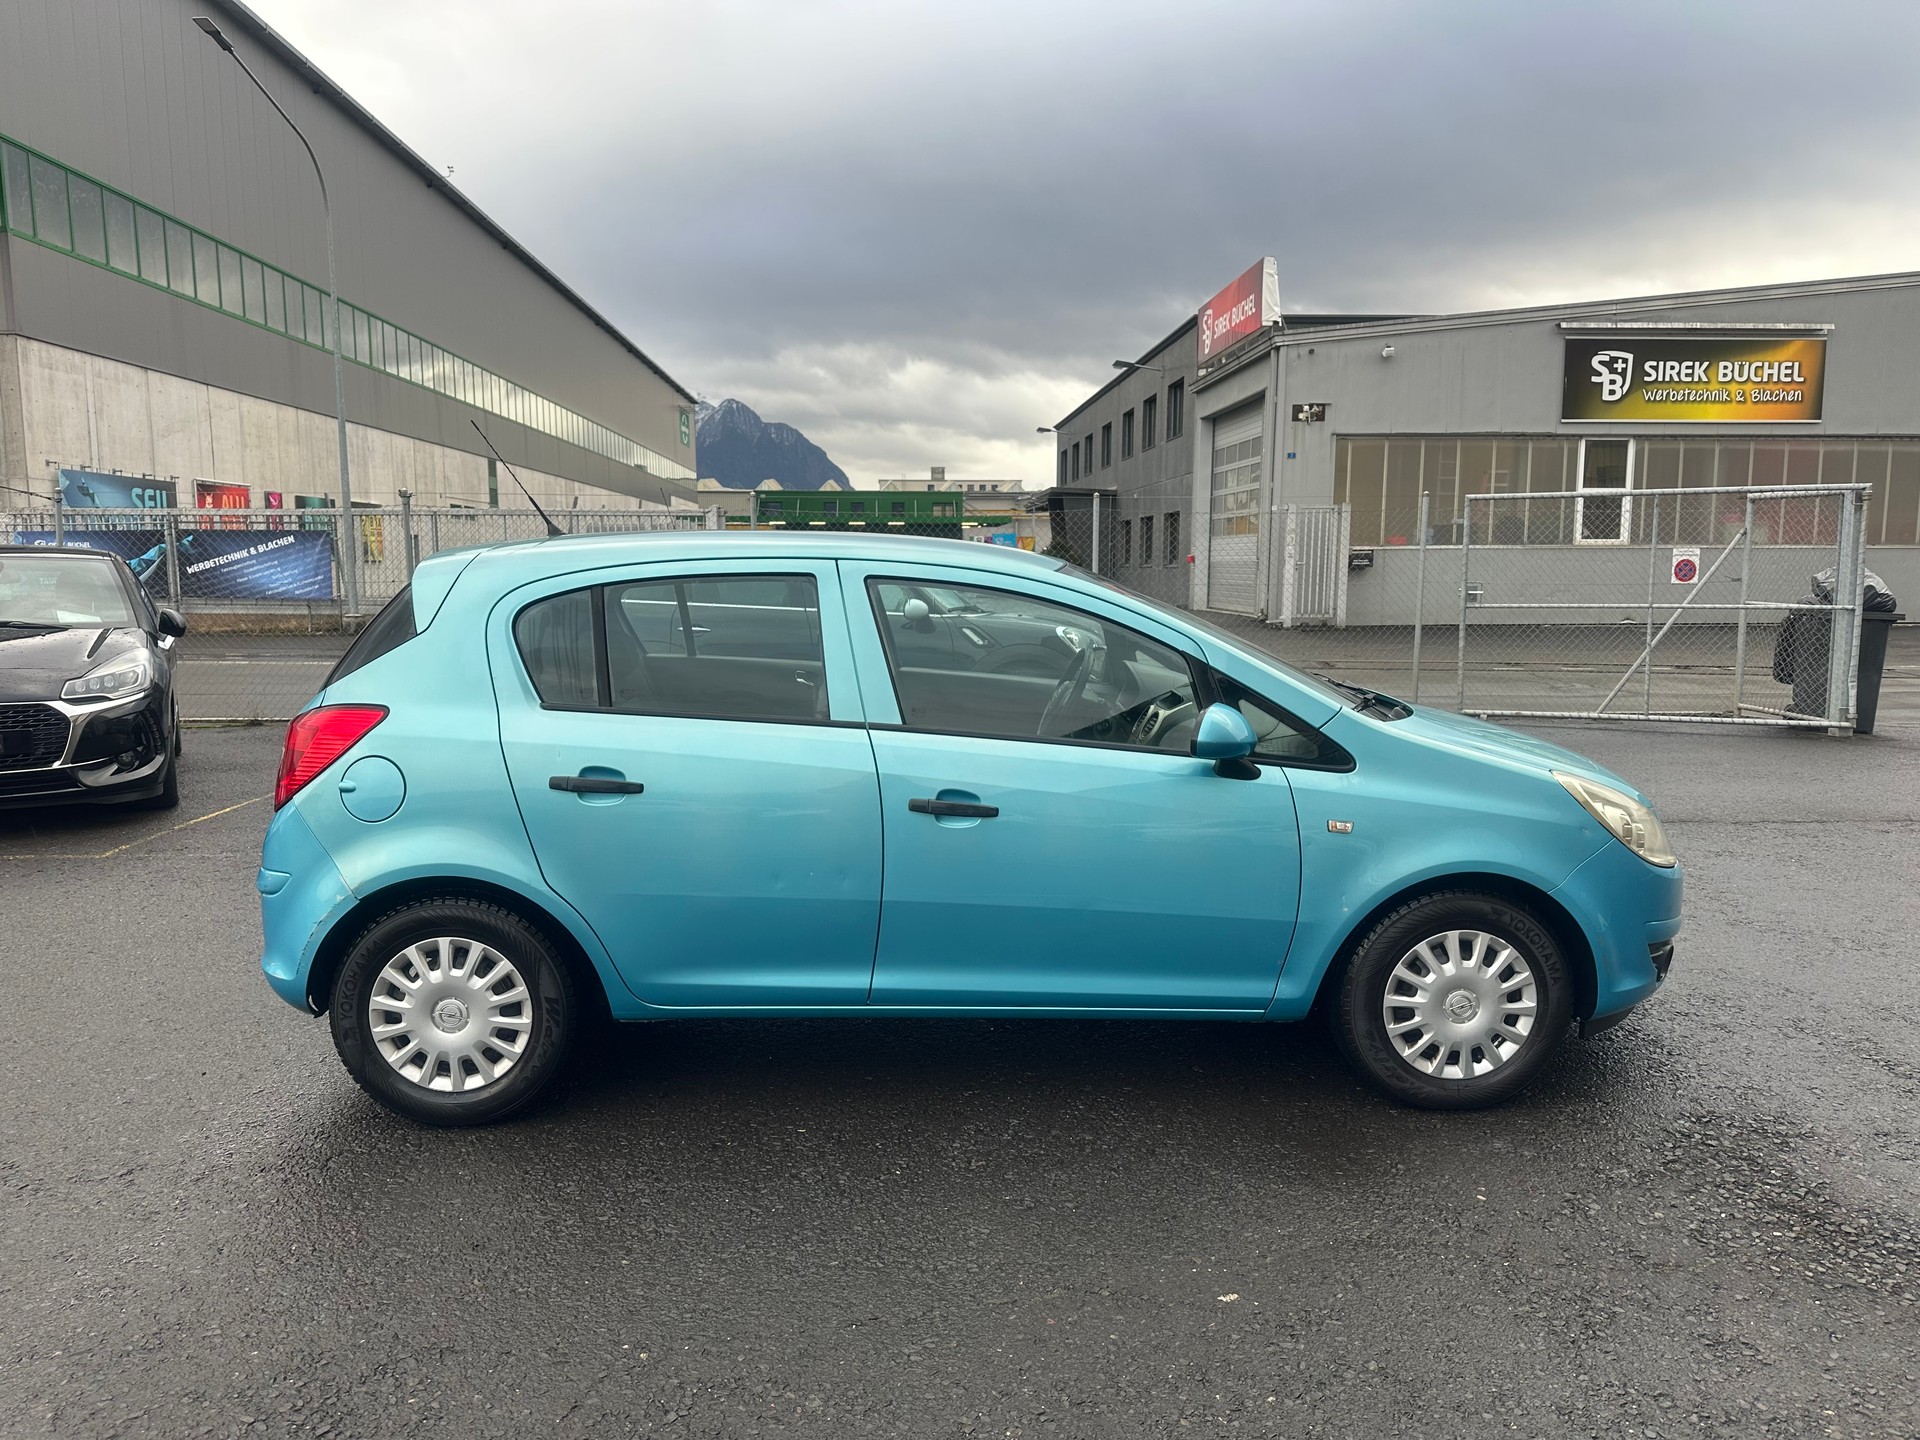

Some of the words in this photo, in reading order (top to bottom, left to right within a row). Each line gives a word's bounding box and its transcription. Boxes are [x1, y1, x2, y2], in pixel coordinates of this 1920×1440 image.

[1214, 310, 1230, 339] SIREK
[1643, 361, 1710, 382] SIREK
[1717, 361, 1805, 383] BÜCHEL
[1643, 388, 1731, 402] Werbetechnik
[1736, 388, 1745, 402] &
[1751, 388, 1802, 402] Blachen
[186, 548, 250, 575] WERBETECHNIK
[250, 546, 257, 556] &
[257, 535, 295, 553] BLACHEN
[1508, 912, 1563, 987] YOKOHAMA
[339, 939, 385, 1021] YOKOHAMA
